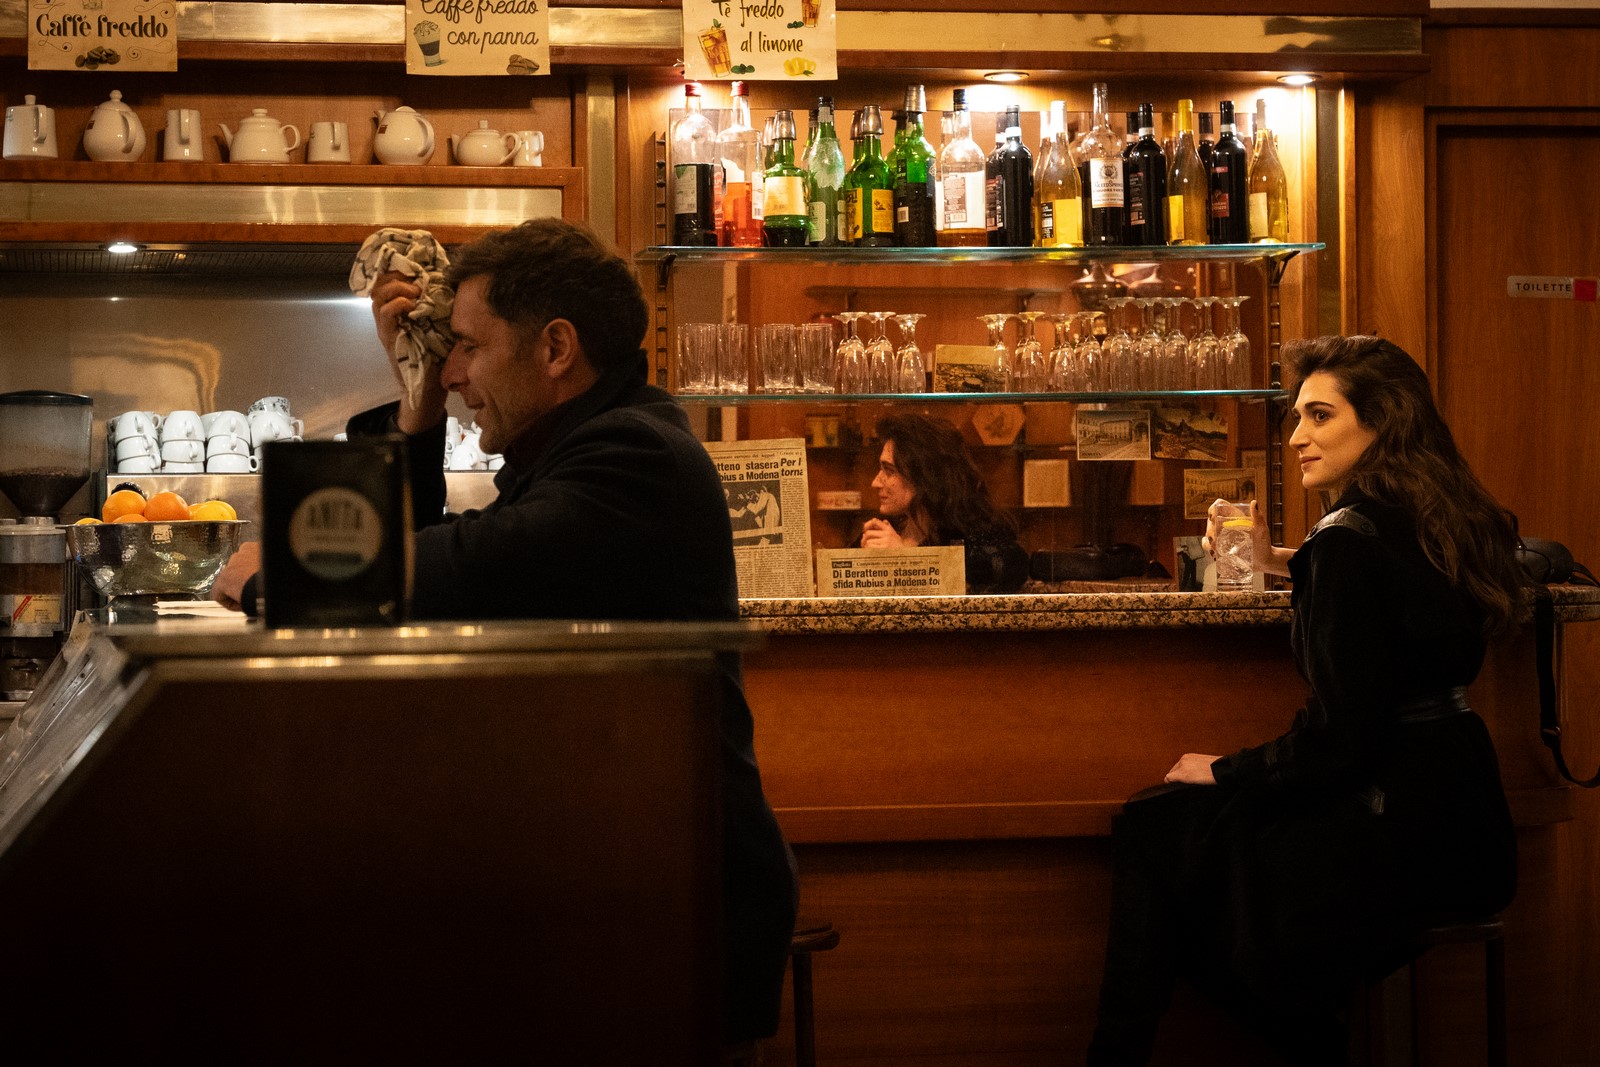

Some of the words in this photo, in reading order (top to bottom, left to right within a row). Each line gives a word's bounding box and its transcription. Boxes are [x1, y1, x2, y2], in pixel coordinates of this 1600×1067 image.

[475, 0, 539, 24] freddo
[739, 0, 784, 28] freddo
[35, 13, 92, 37] Caffé
[97, 14, 168, 38] freddo
[447, 31, 480, 45] con
[480, 31, 539, 54] panna
[740, 31, 752, 52] al
[758, 31, 803, 52] limone
[1516, 283, 1571, 292] TOILETTE
[716, 463, 741, 471] tteno
[745, 461, 779, 470] stasera
[780, 458, 796, 467] Per
[746, 471, 779, 480] Modena
[833, 570, 842, 578] Di
[845, 569, 888, 578] Beratteno
[894, 568, 927, 577] stasera
[832, 580, 854, 589] sfida
[855, 579, 885, 588] Rubius
[894, 577, 927, 587] Modena
